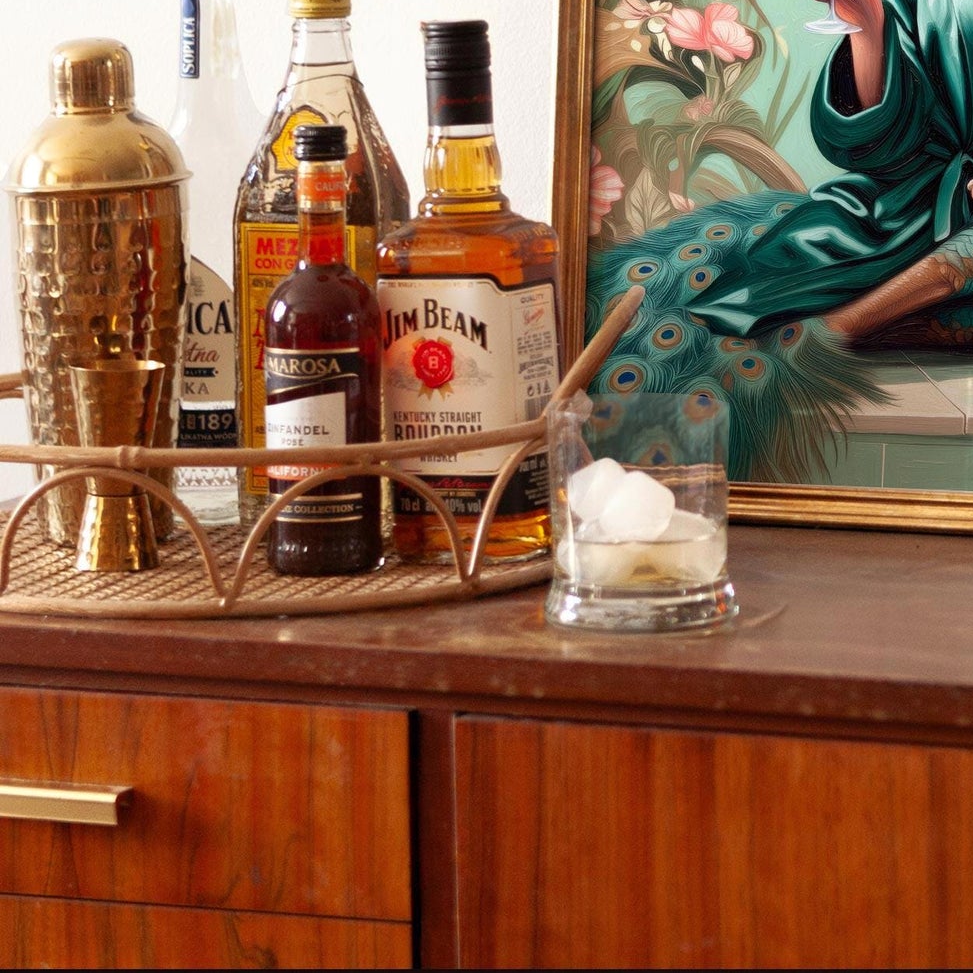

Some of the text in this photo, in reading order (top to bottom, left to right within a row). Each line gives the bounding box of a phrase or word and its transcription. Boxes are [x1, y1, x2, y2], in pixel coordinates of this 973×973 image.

[183, 17, 196, 74] SOPLICA
[256, 237, 299, 255] MEZ
[255, 258, 279, 269] CON
[187, 301, 233, 334] ICA
[383, 308, 419, 352] JIM
[424, 298, 488, 352] BEAM
[267, 358, 341, 374] MAROSA
[185, 382, 209, 395] KA
[198, 413, 234, 430] 189
[394, 411, 482, 423] KENTUCKY STRAIGHT
[268, 423, 330, 435] ZINFANDEL
[294, 504, 355, 514] COLLECTION
[467, 499, 482, 512] vol
